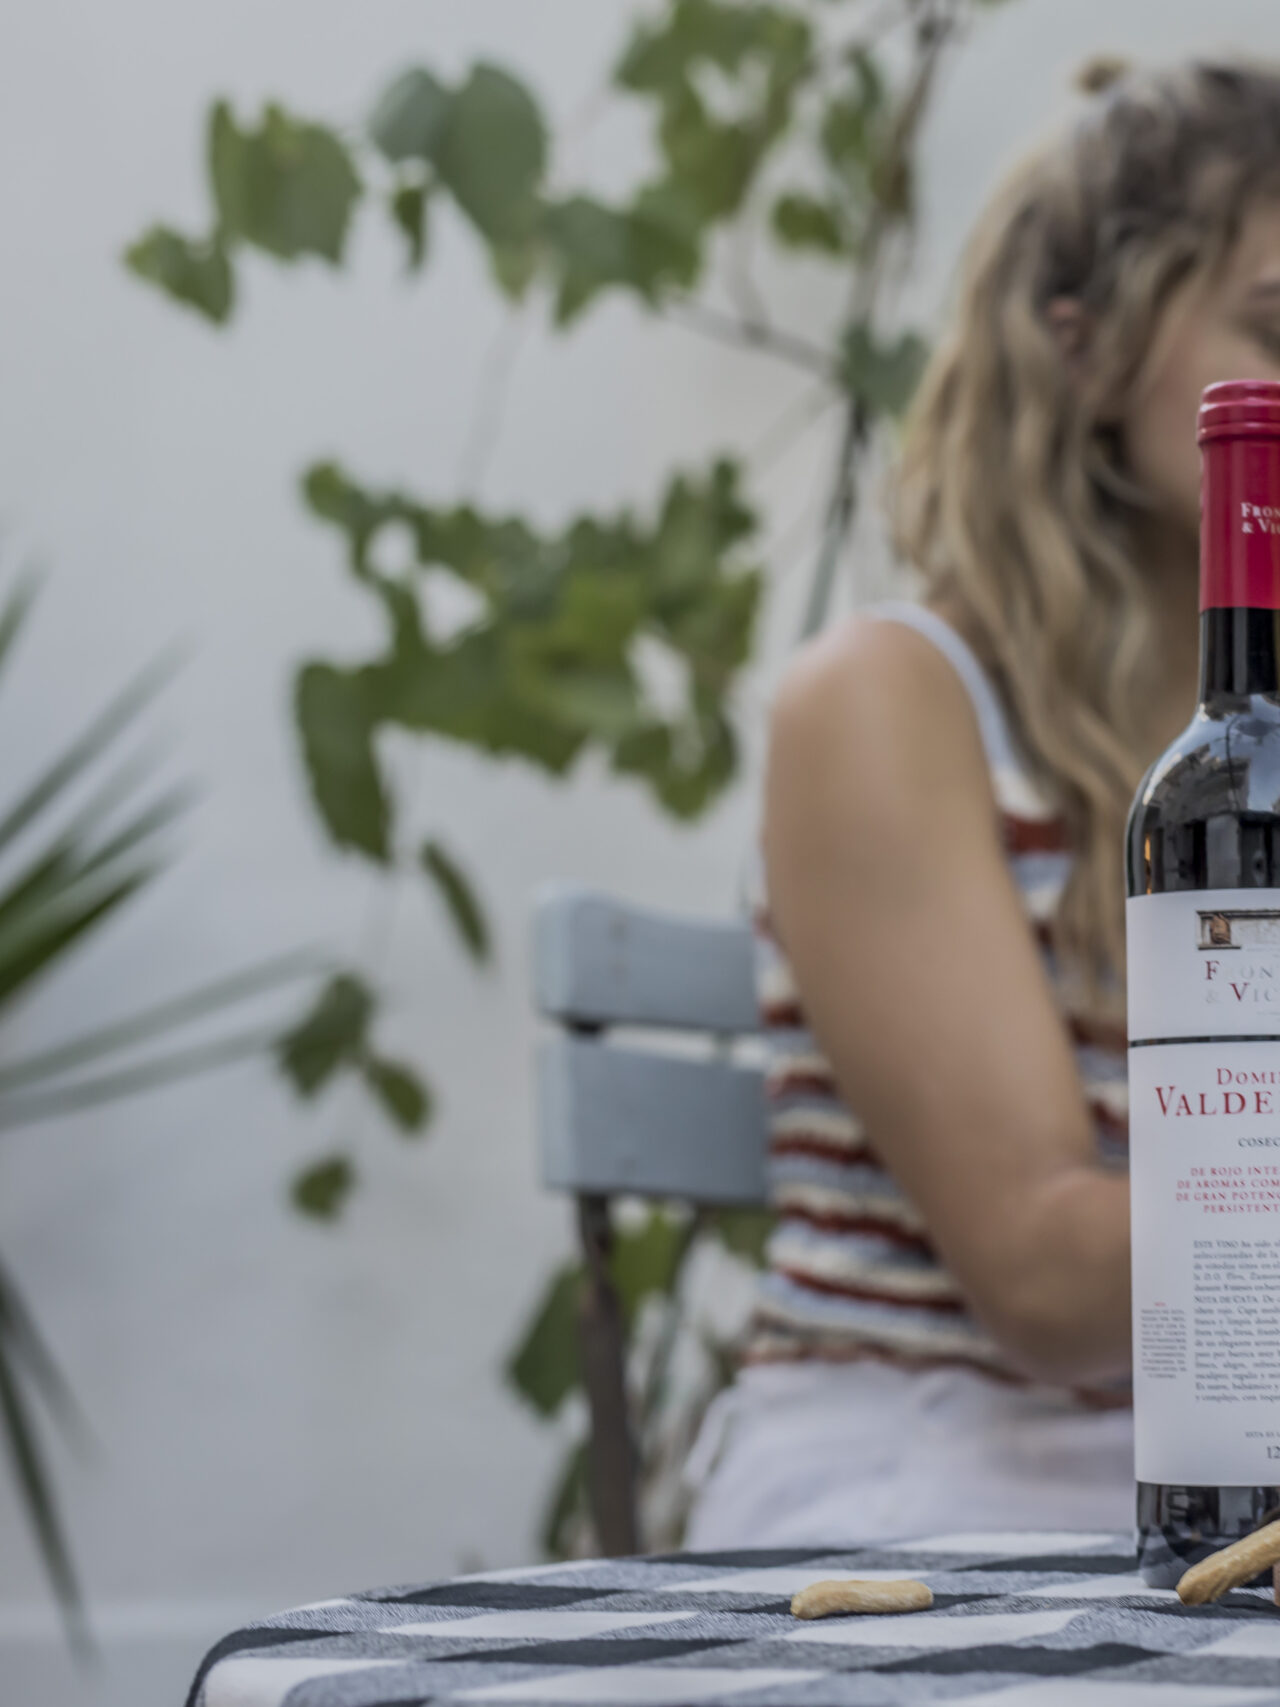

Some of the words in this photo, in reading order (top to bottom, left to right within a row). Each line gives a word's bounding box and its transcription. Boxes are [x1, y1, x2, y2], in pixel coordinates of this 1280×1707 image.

[1191, 1167, 1204, 1176] DE
[1210, 1167, 1242, 1175] ROJO
[1177, 1180, 1190, 1189] DE
[1197, 1179, 1245, 1188] AROMAS
[1176, 1192, 1189, 1201] DE
[1194, 1192, 1226, 1200] GRAN
